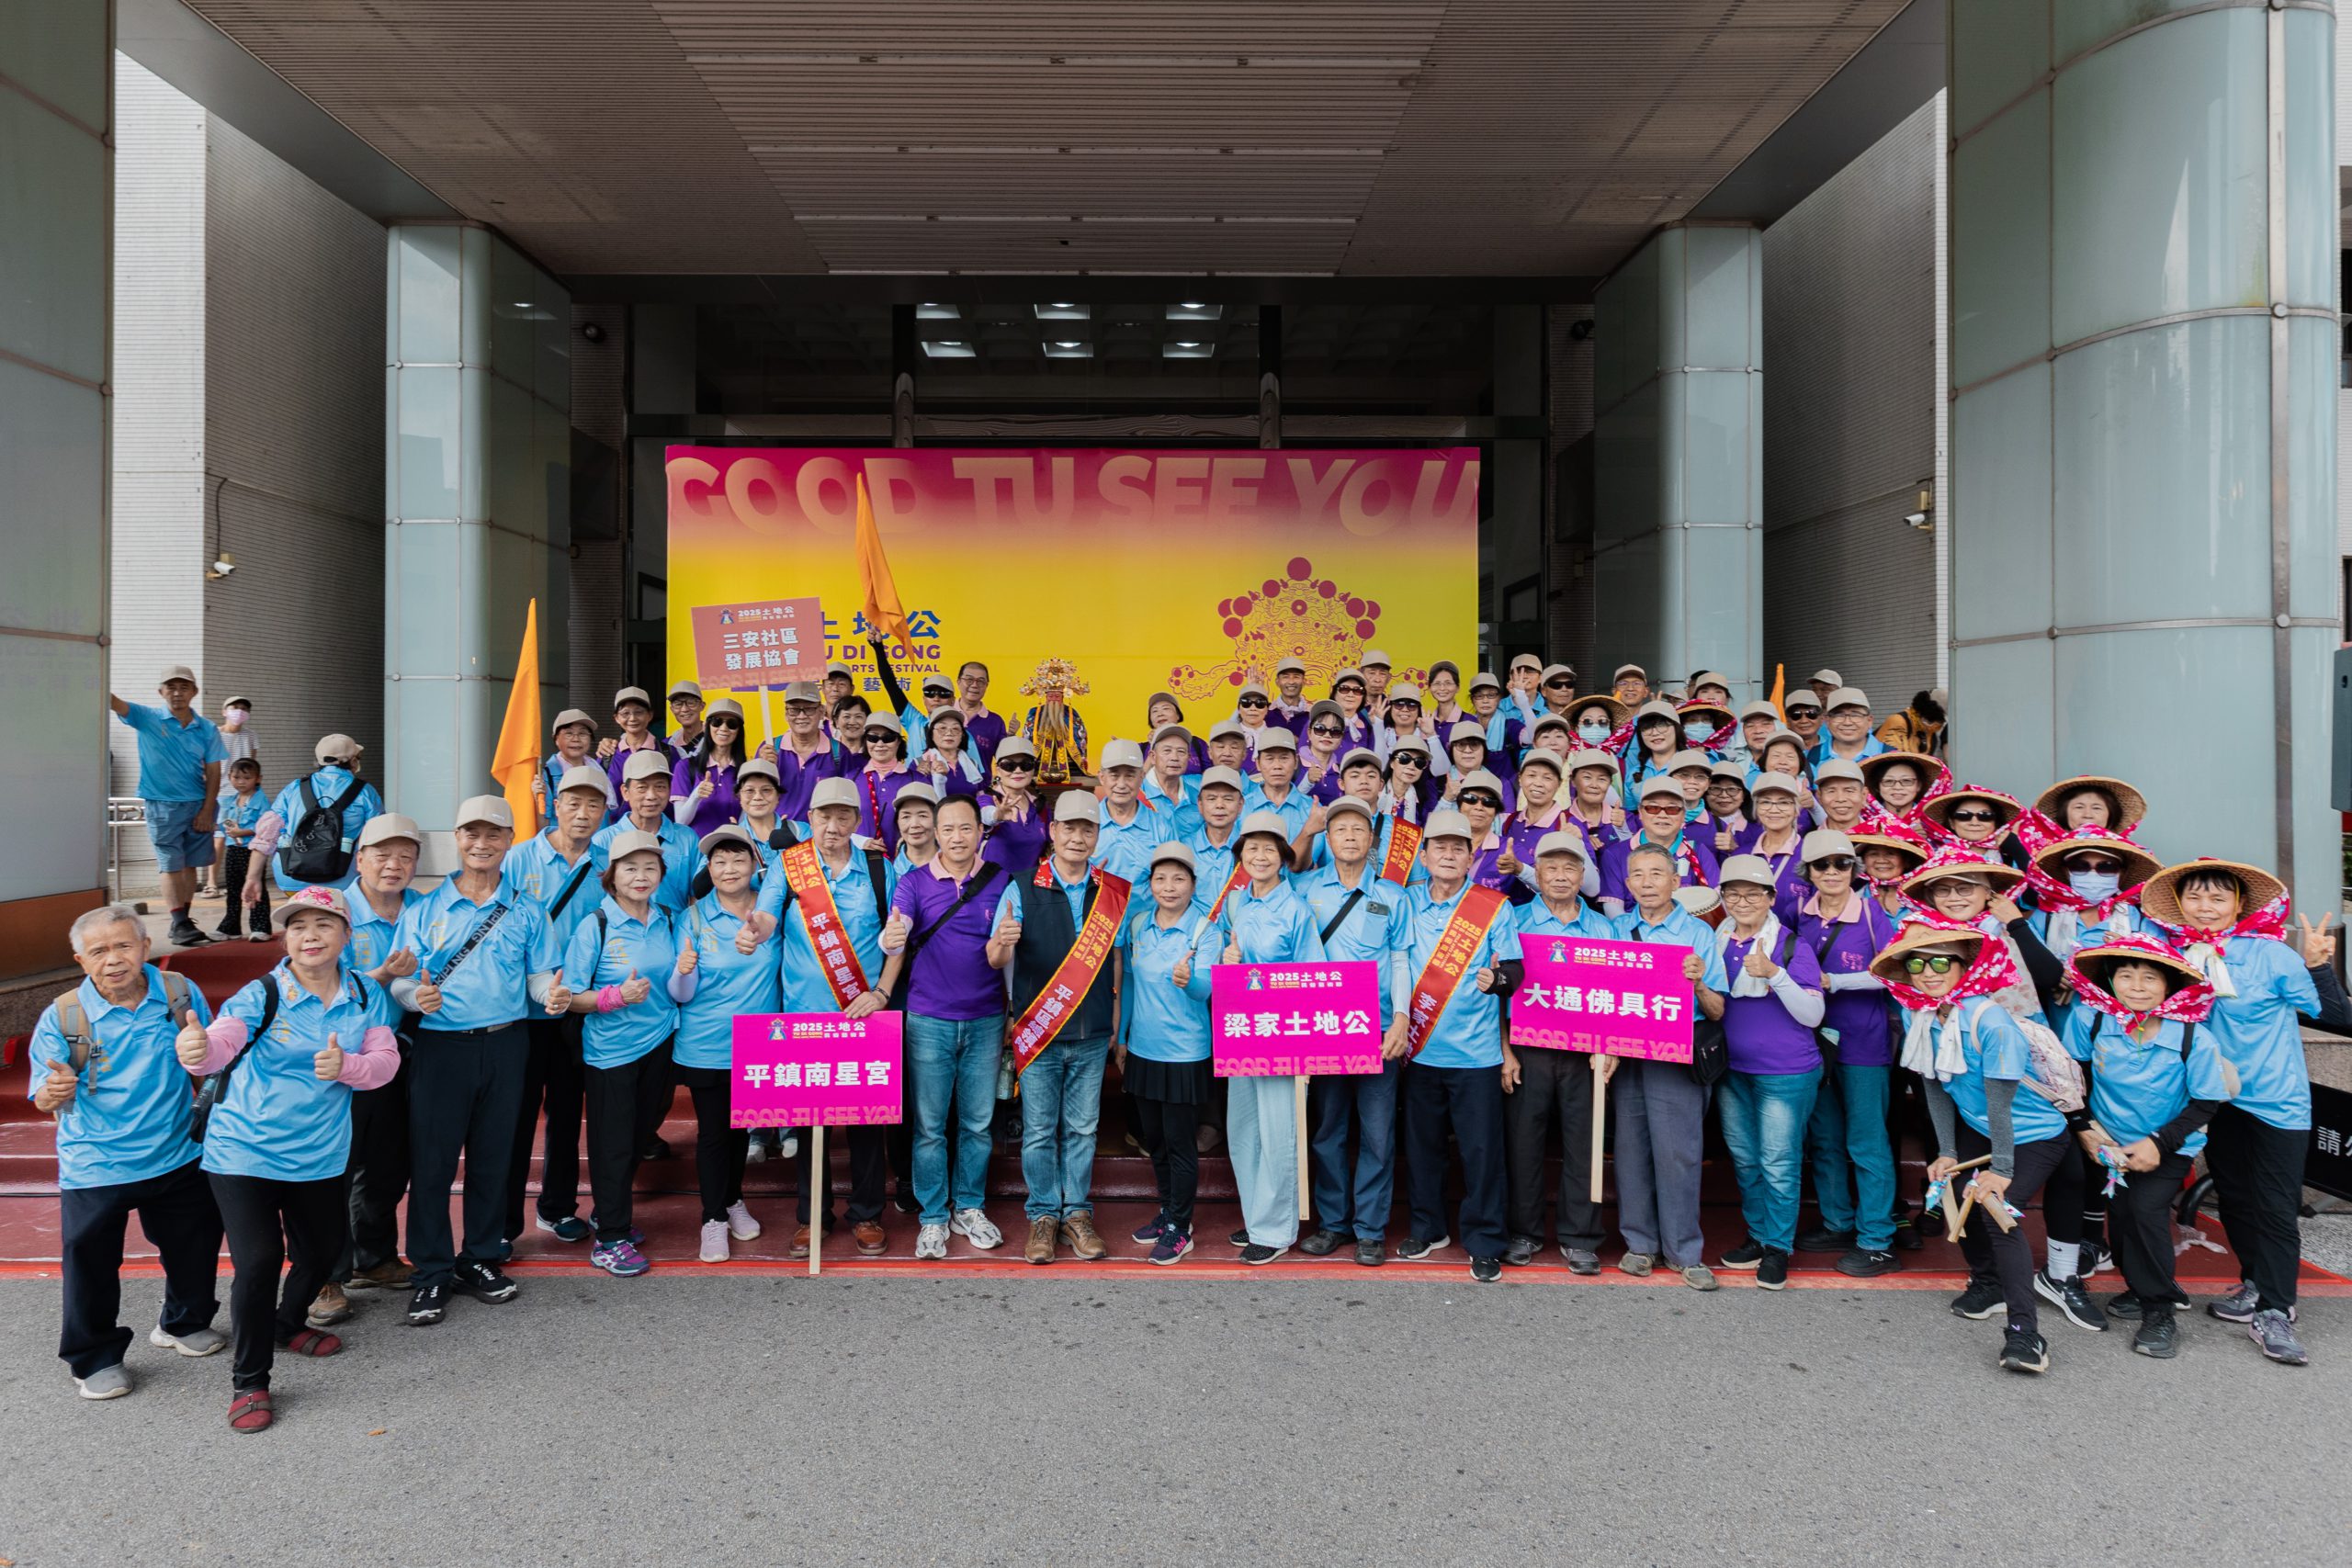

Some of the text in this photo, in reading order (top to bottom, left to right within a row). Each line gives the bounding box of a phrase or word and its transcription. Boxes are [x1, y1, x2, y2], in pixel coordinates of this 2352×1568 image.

[666, 456, 1480, 536] GOOD TU SEE YOU
[723, 627, 799, 650] 三安社區
[725, 649, 800, 671] 發展協會
[842, 645, 865, 660] DI
[852, 664, 875, 672] RTS
[1454, 916, 1483, 936] 2025
[811, 913, 861, 1001] 平鎮南星宮
[1444, 938, 1474, 977] 土地公
[1574, 947, 1607, 958] 2025
[1607, 950, 1654, 964] 土地公
[1270, 973, 1299, 982] 2025
[1300, 971, 1342, 982] 土地公
[1522, 983, 1682, 1021] 大通佛具行
[793, 1022, 823, 1032] 2025
[823, 1021, 866, 1032] 土地公
[1224, 1010, 1371, 1038] 梁家土地公
[743, 1060, 891, 1089] 平鎮南星宮
